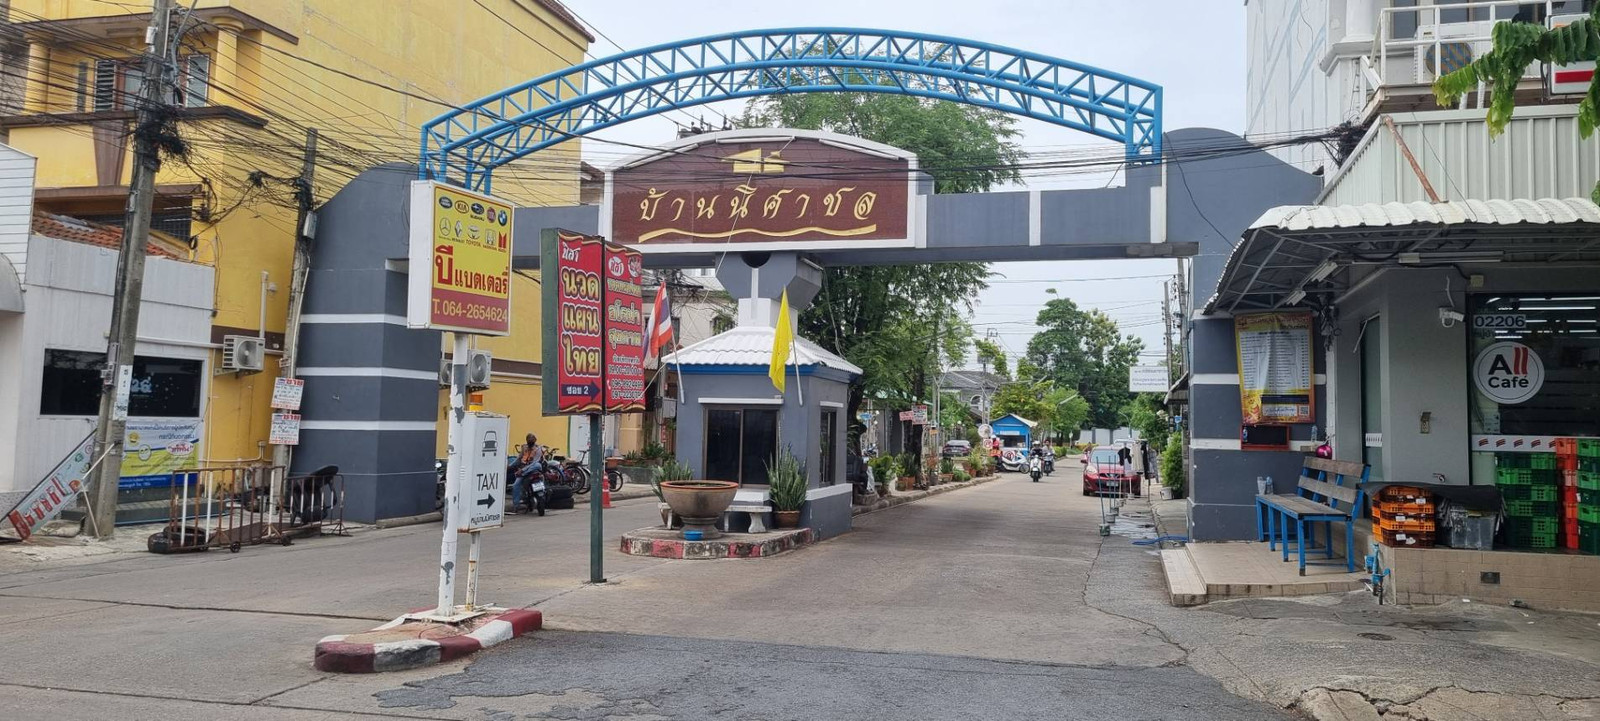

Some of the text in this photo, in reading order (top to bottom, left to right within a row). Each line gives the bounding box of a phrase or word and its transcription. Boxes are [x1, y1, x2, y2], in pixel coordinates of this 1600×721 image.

[466, 239, 481, 248] TOYOTA
[562, 267, 600, 302] นวด
[433, 298, 508, 323] T. 064-2654624
[563, 302, 600, 336] แผน
[1474, 315, 1526, 328] 02206
[562, 332, 600, 377] ไทย
[1488, 347, 1529, 376] All
[566, 385, 589, 395] ซอย 2
[1488, 375, 1530, 389] Café
[476, 472, 499, 491] TAXI
